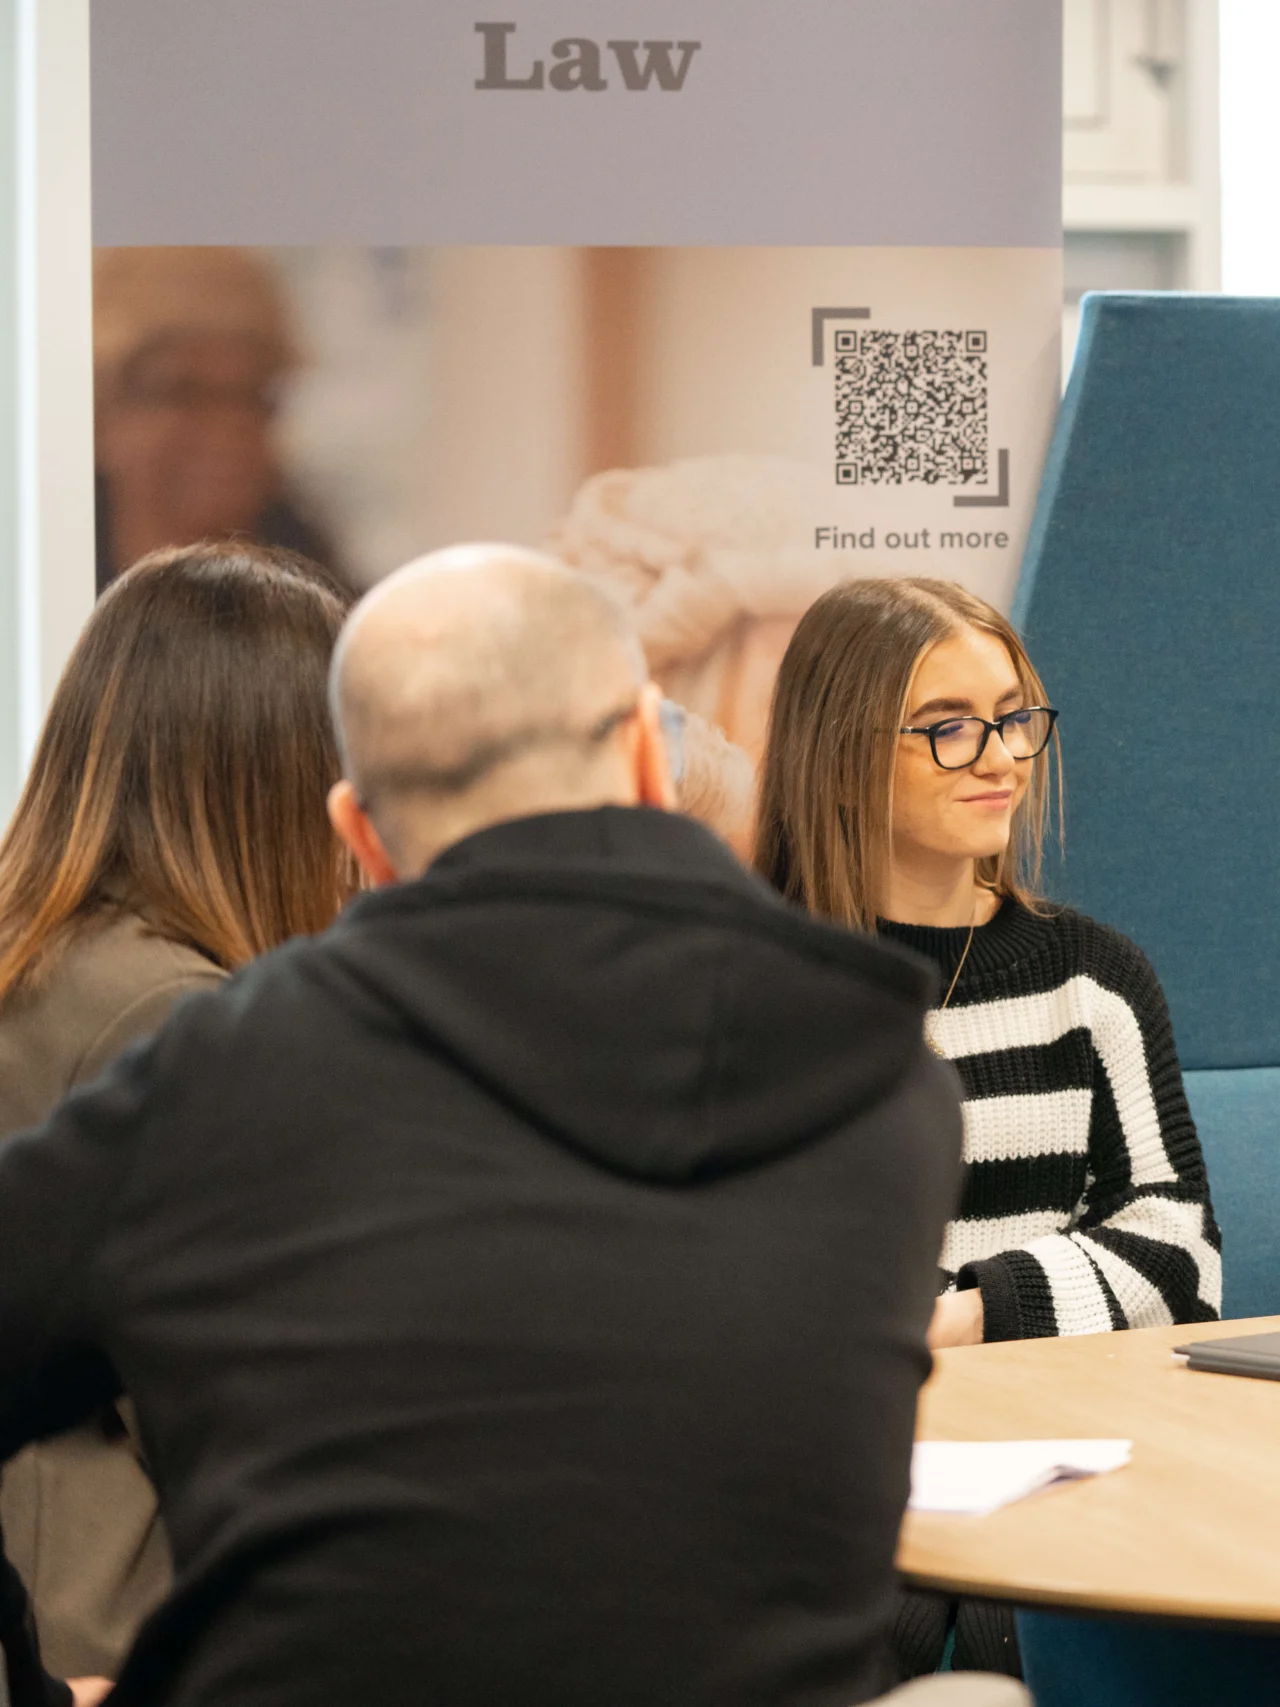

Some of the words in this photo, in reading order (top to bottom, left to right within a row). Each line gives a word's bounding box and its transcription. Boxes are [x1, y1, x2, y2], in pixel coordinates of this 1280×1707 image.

[474, 22, 702, 91] Law
[814, 526, 875, 549] Find
[885, 528, 931, 549] out
[940, 531, 1009, 549] more
